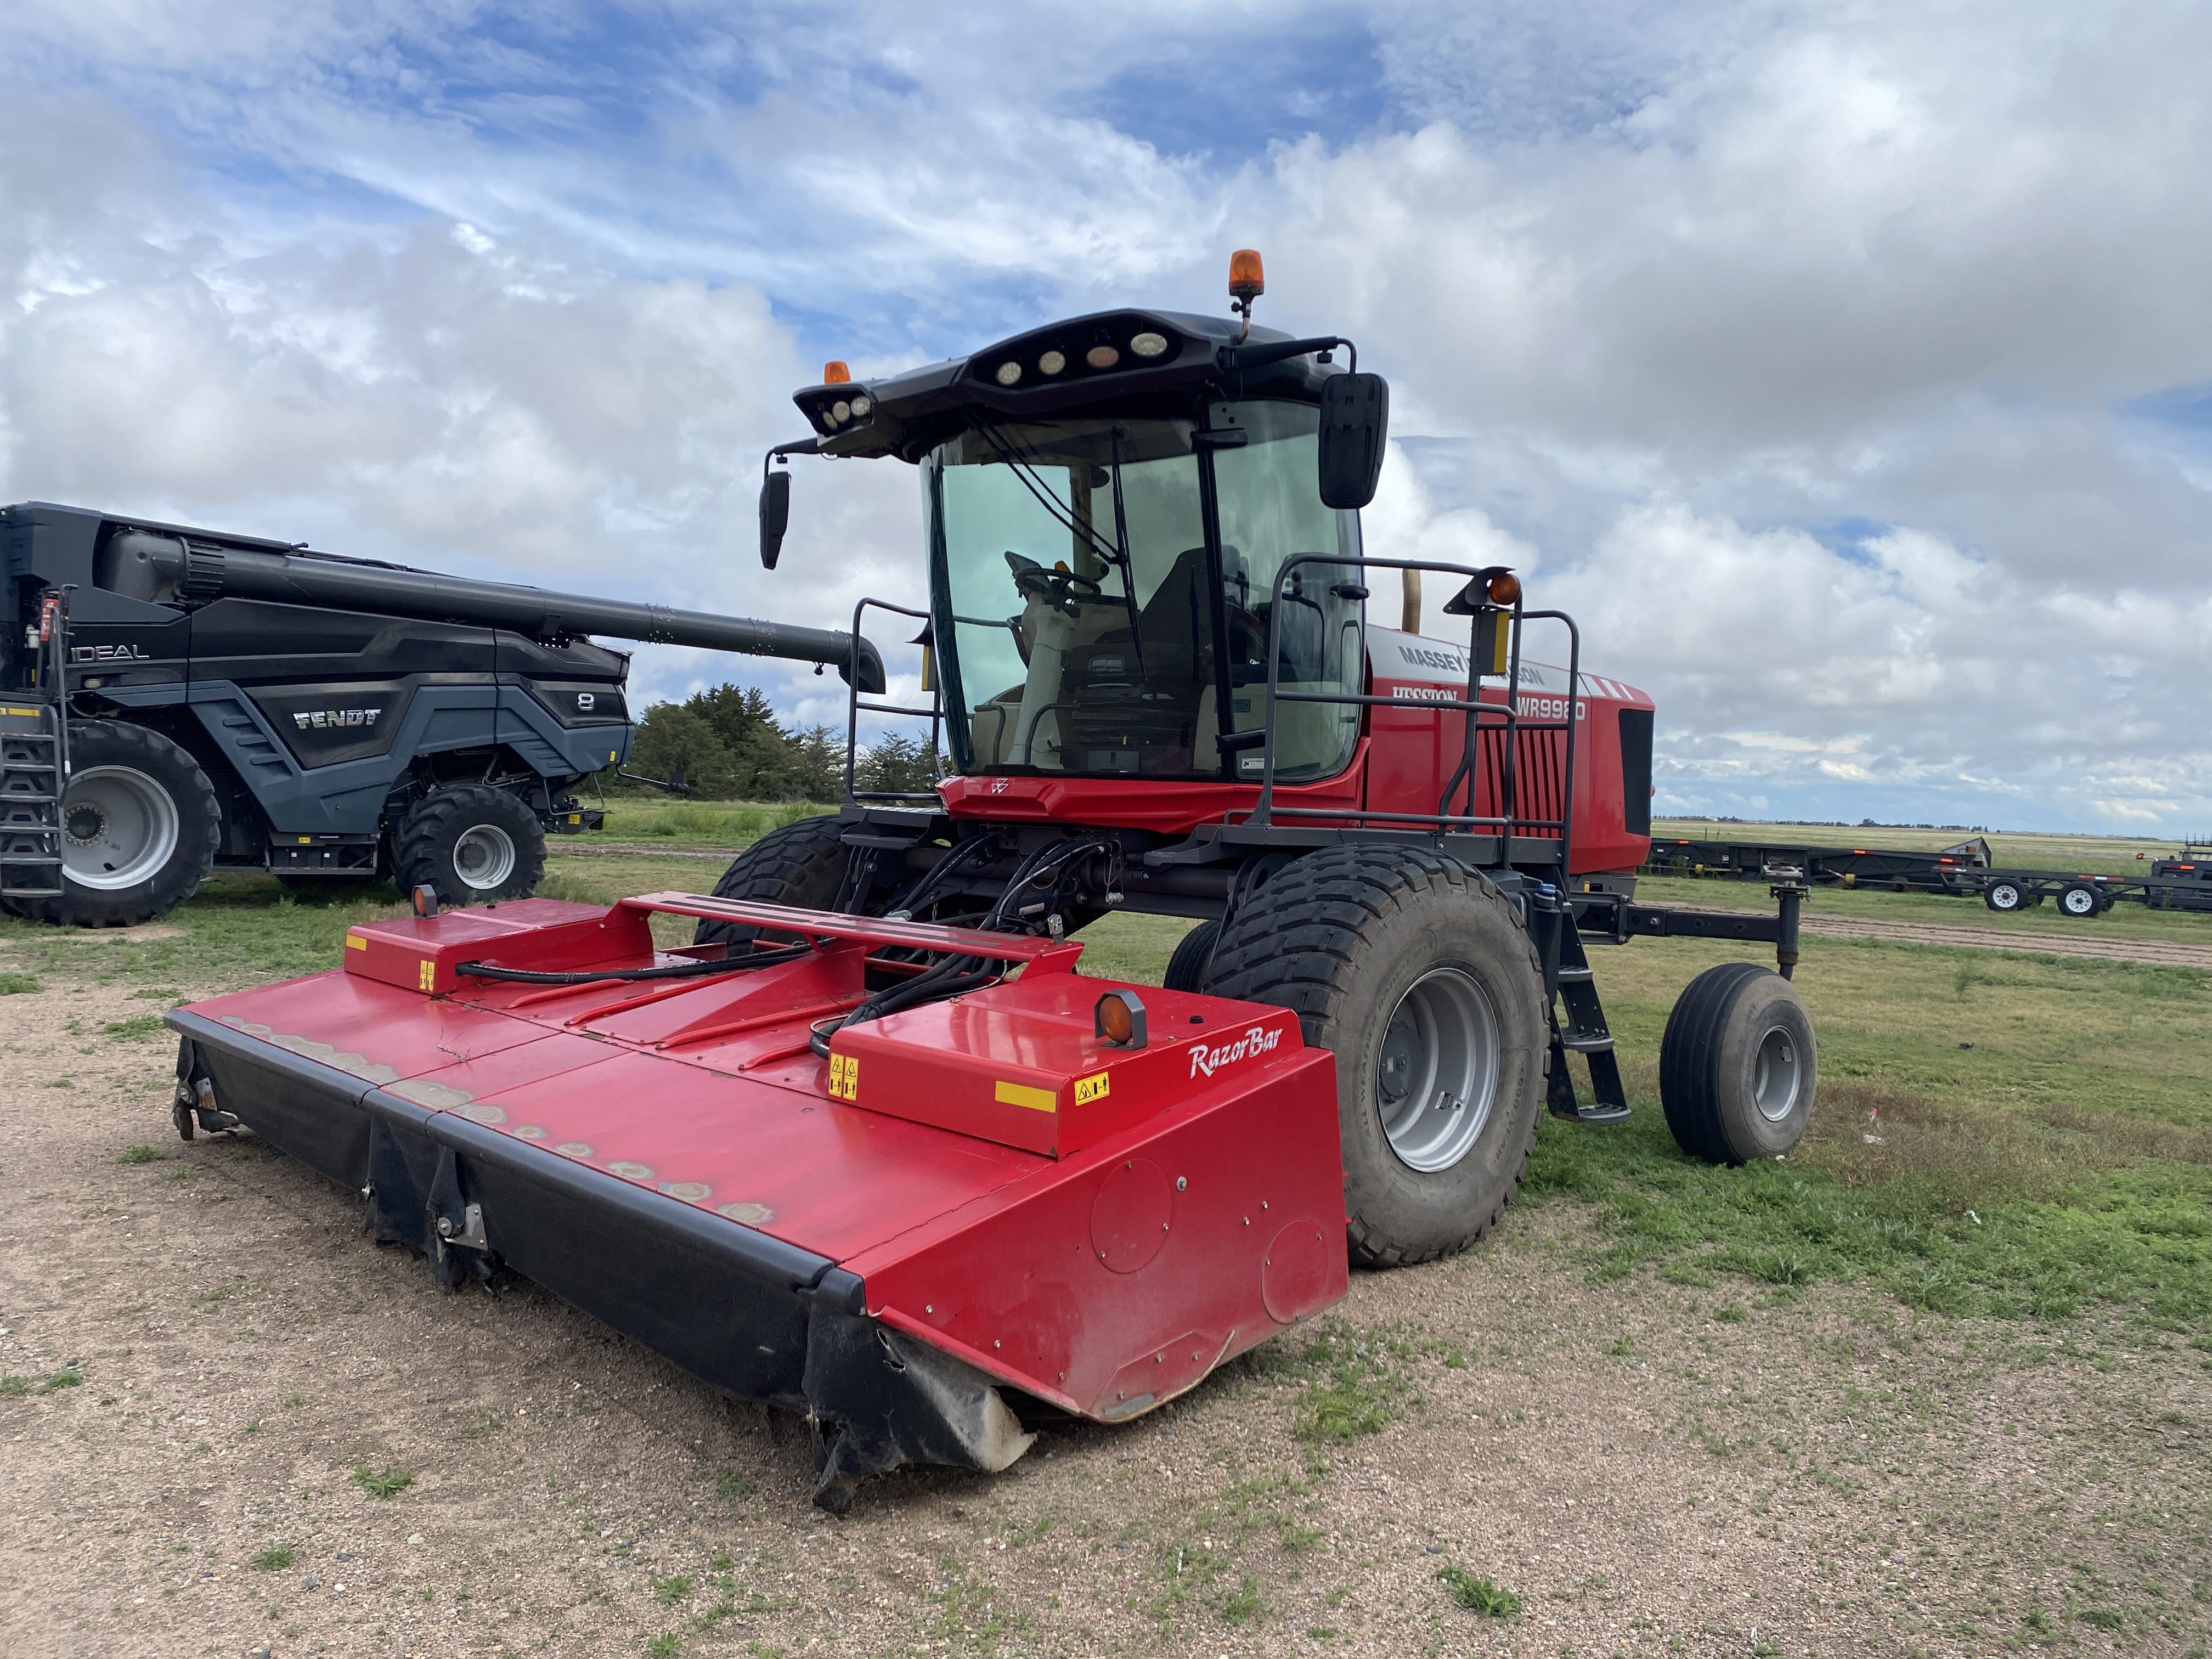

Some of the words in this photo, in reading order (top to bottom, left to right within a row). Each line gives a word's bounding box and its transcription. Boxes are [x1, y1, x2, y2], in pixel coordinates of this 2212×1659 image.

[71, 645, 149, 663] IDEAL
[1398, 646, 1465, 673] MASSEY
[578, 693, 594, 711] 8
[293, 709, 381, 729] FENDT
